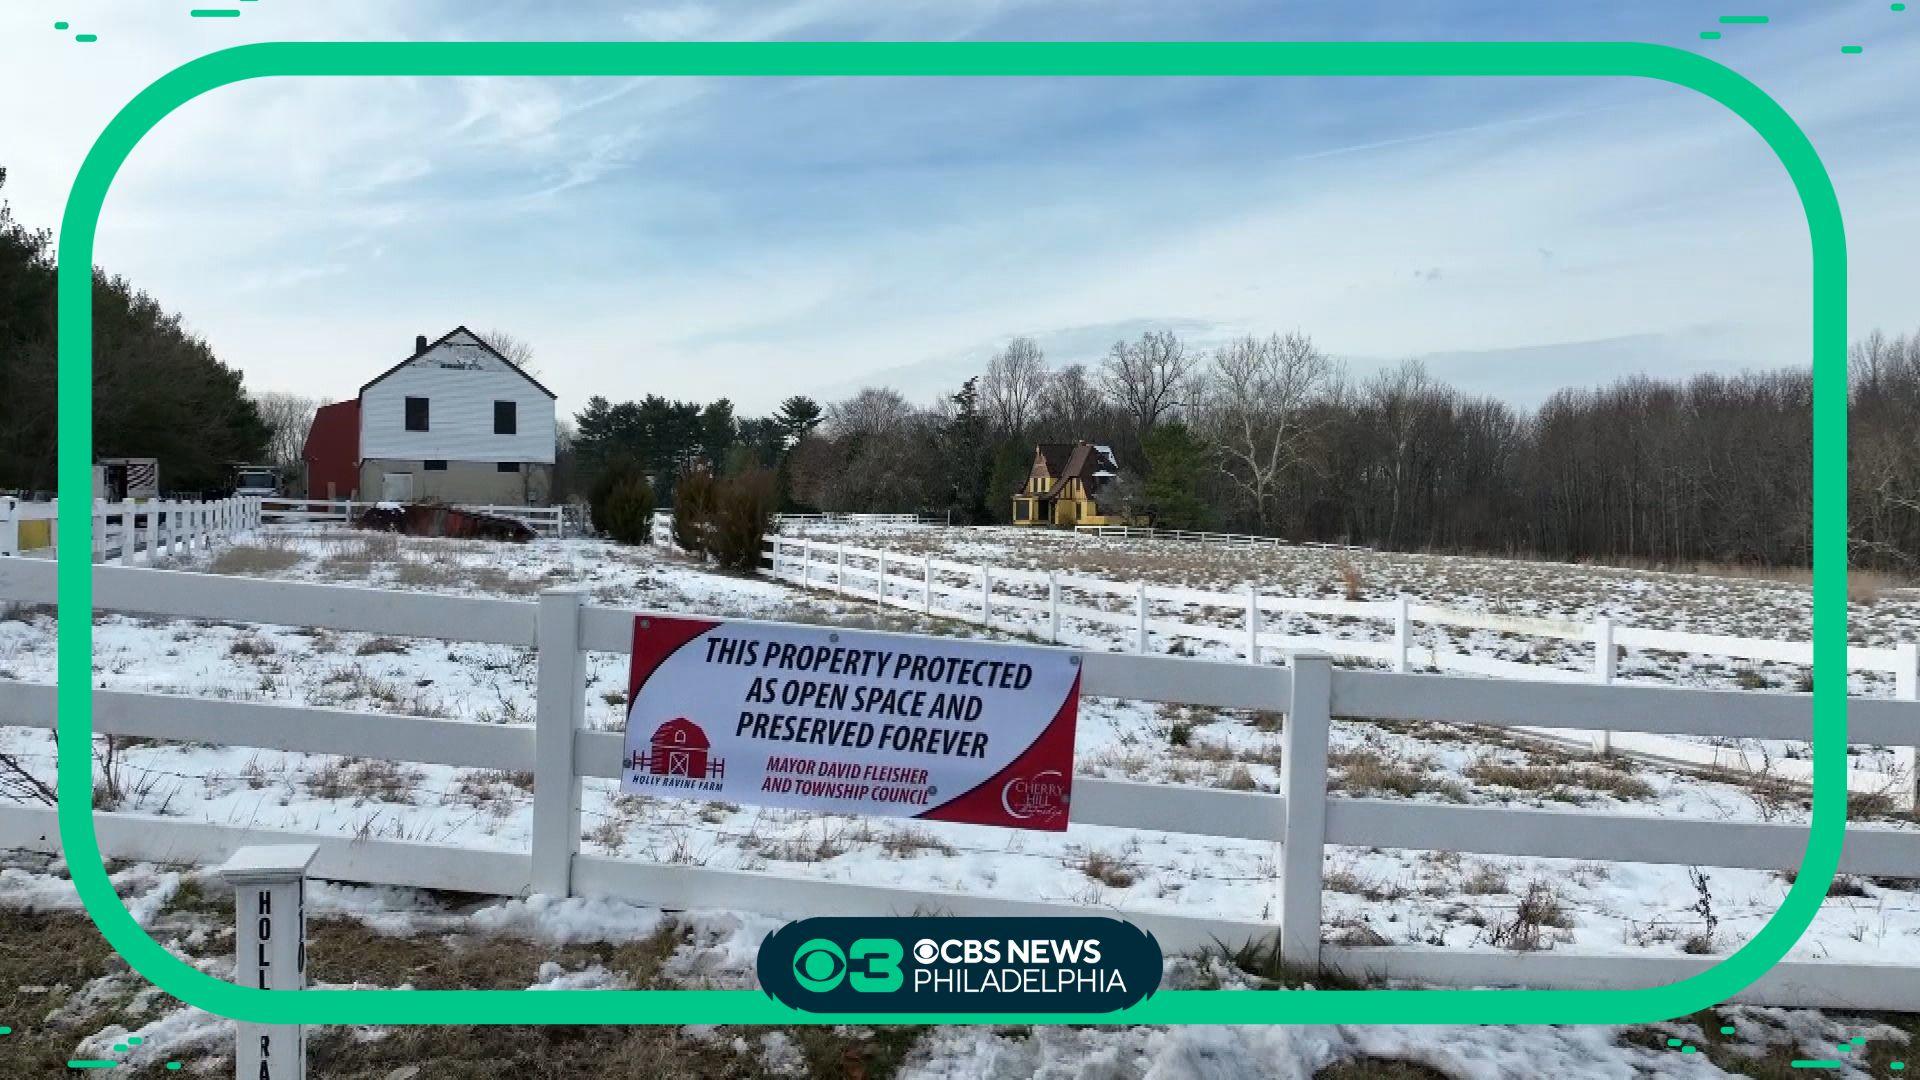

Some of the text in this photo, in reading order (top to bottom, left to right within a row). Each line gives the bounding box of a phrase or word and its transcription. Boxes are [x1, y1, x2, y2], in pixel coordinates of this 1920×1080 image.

[705, 637, 1033, 690] THIS PROPERTY PROTECTED
[745, 677, 983, 721] AS OPEN SPACE AND
[736, 711, 989, 759] PRESERVED FOREVER
[632, 774, 723, 792] HOLLY RAVINE FARM
[761, 777, 929, 805] AND TOWNSHIP COUNCIL
[766, 755, 929, 785] MAYOR DAVID FLEISHER
[258, 891, 271, 991] HOLL
